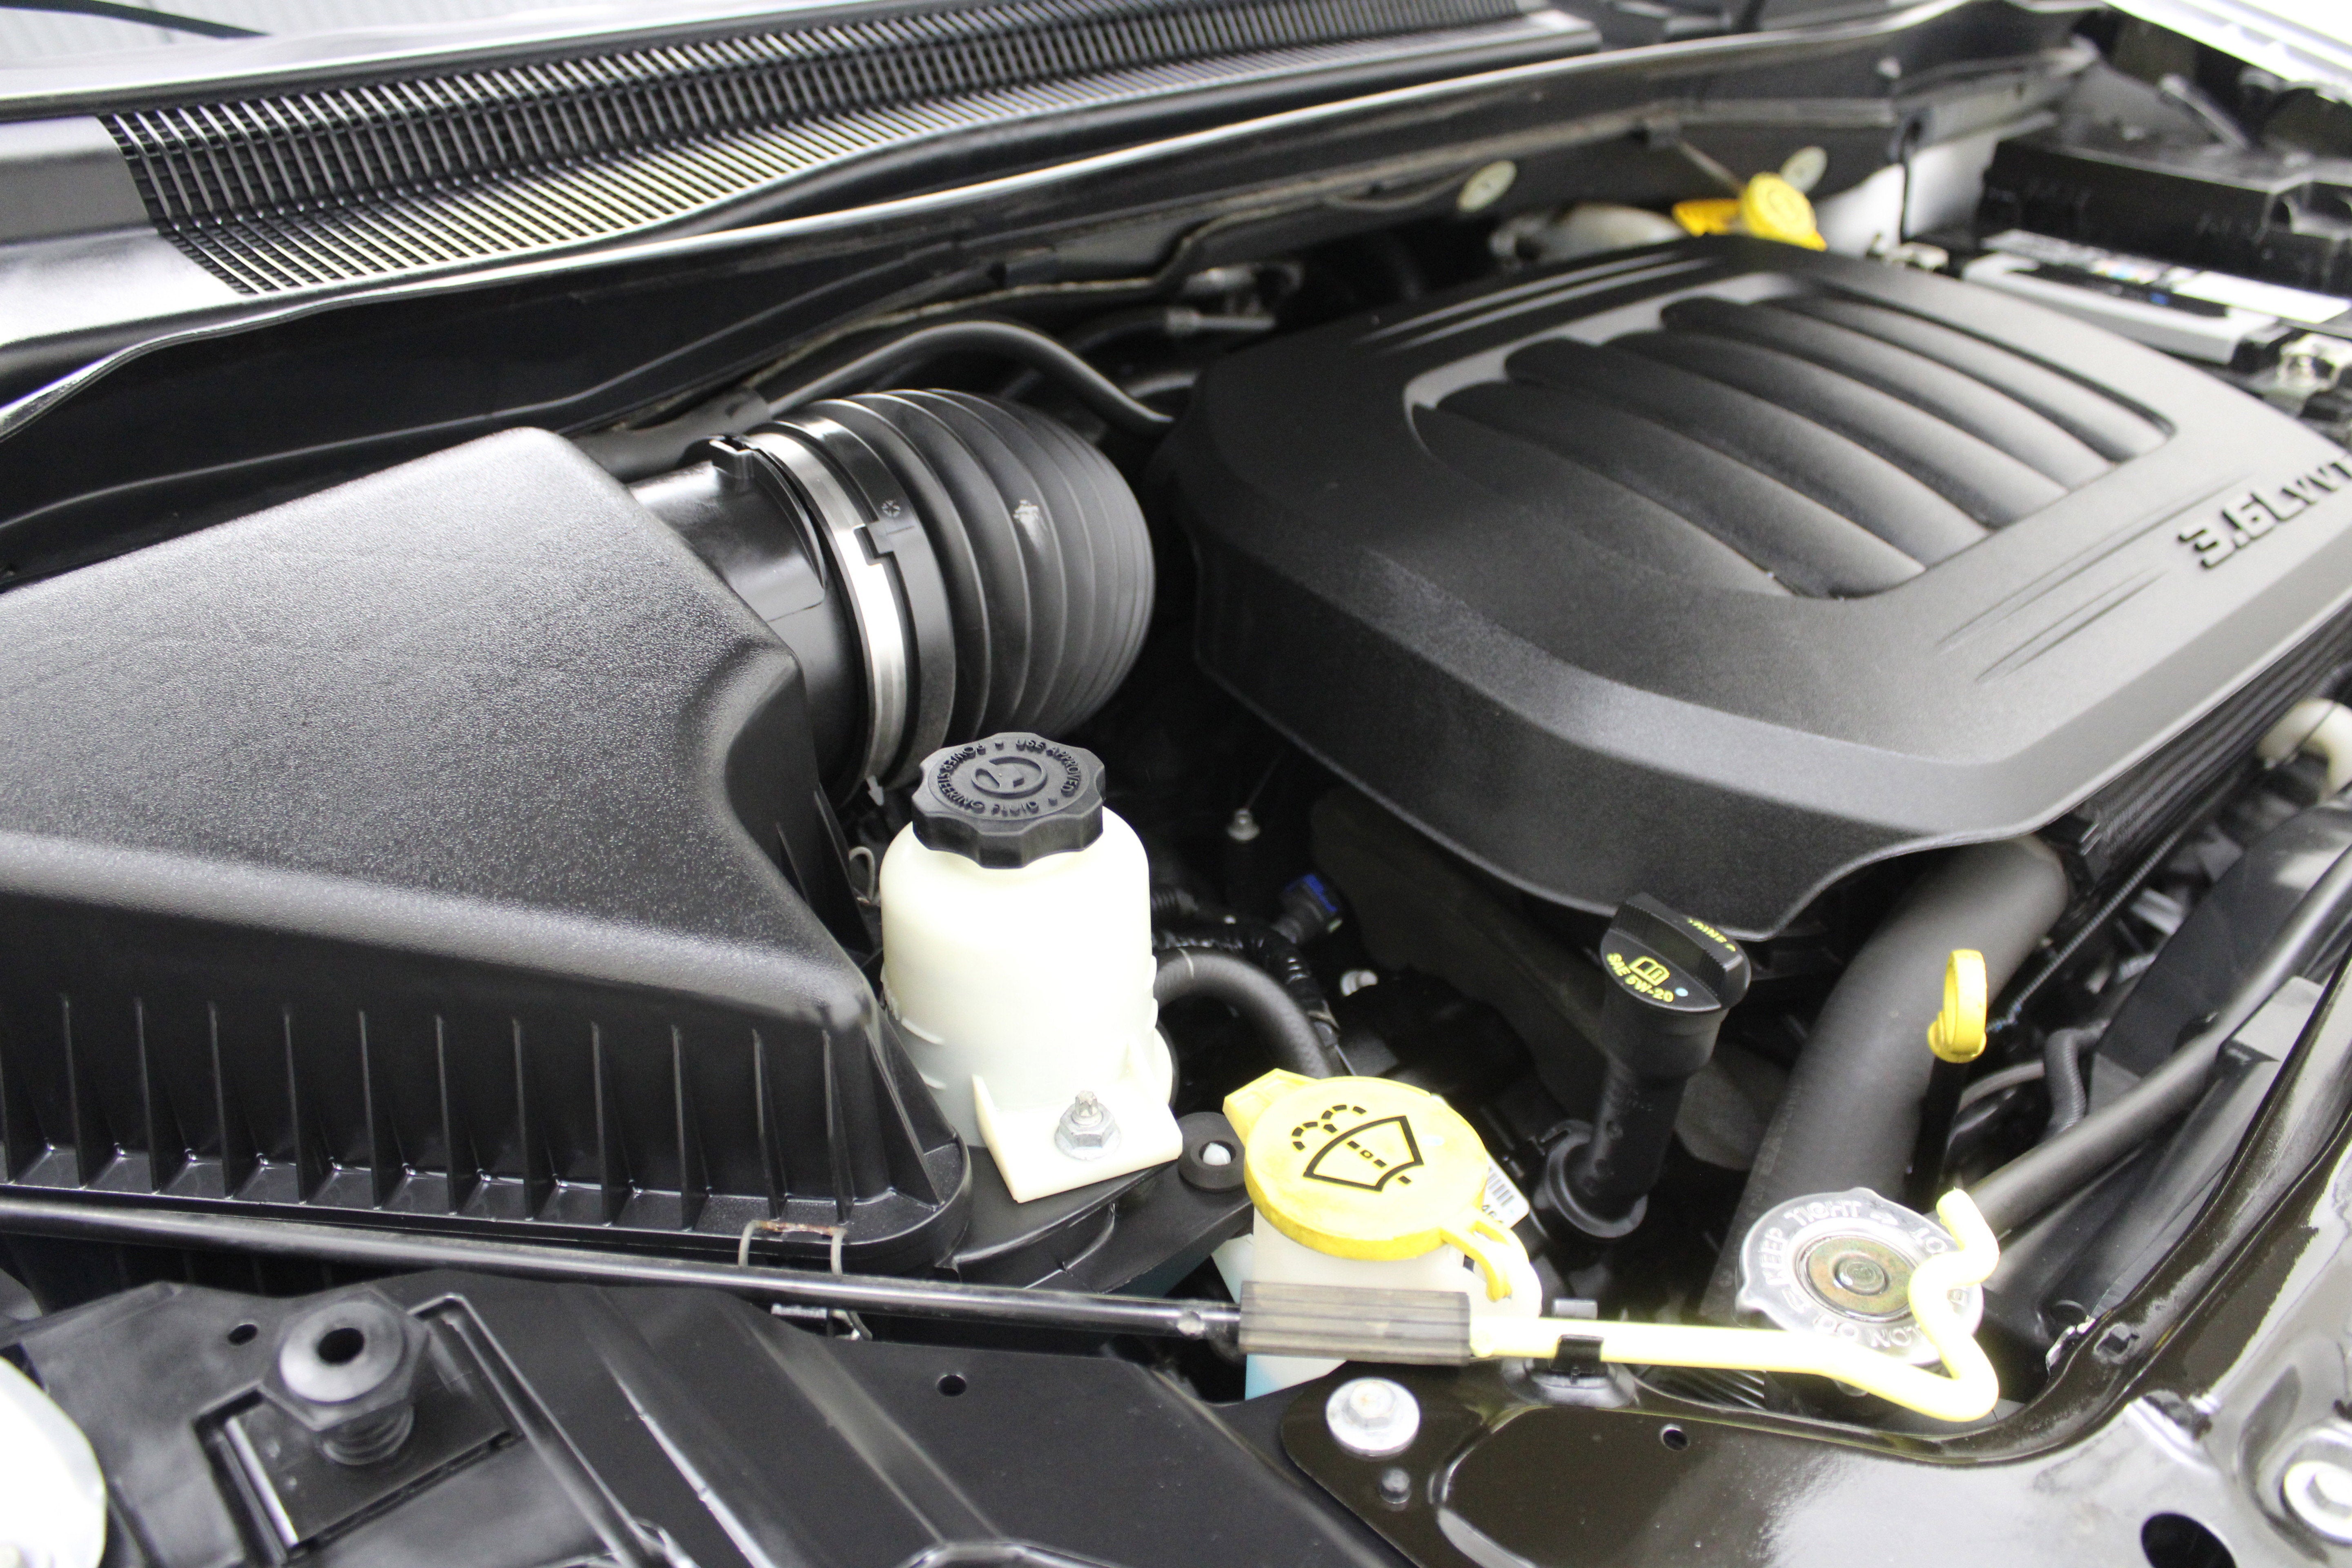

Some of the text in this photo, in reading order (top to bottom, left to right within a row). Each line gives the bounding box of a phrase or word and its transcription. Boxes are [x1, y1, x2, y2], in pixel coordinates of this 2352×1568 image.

[940, 743, 986, 774] POWER
[1016, 739, 1081, 797] USE APPROVED
[937, 772, 985, 814] STEERING
[1606, 953, 1674, 1002] SAE 5W-20
[1758, 1200, 1862, 1285] KEEP TIGHT
